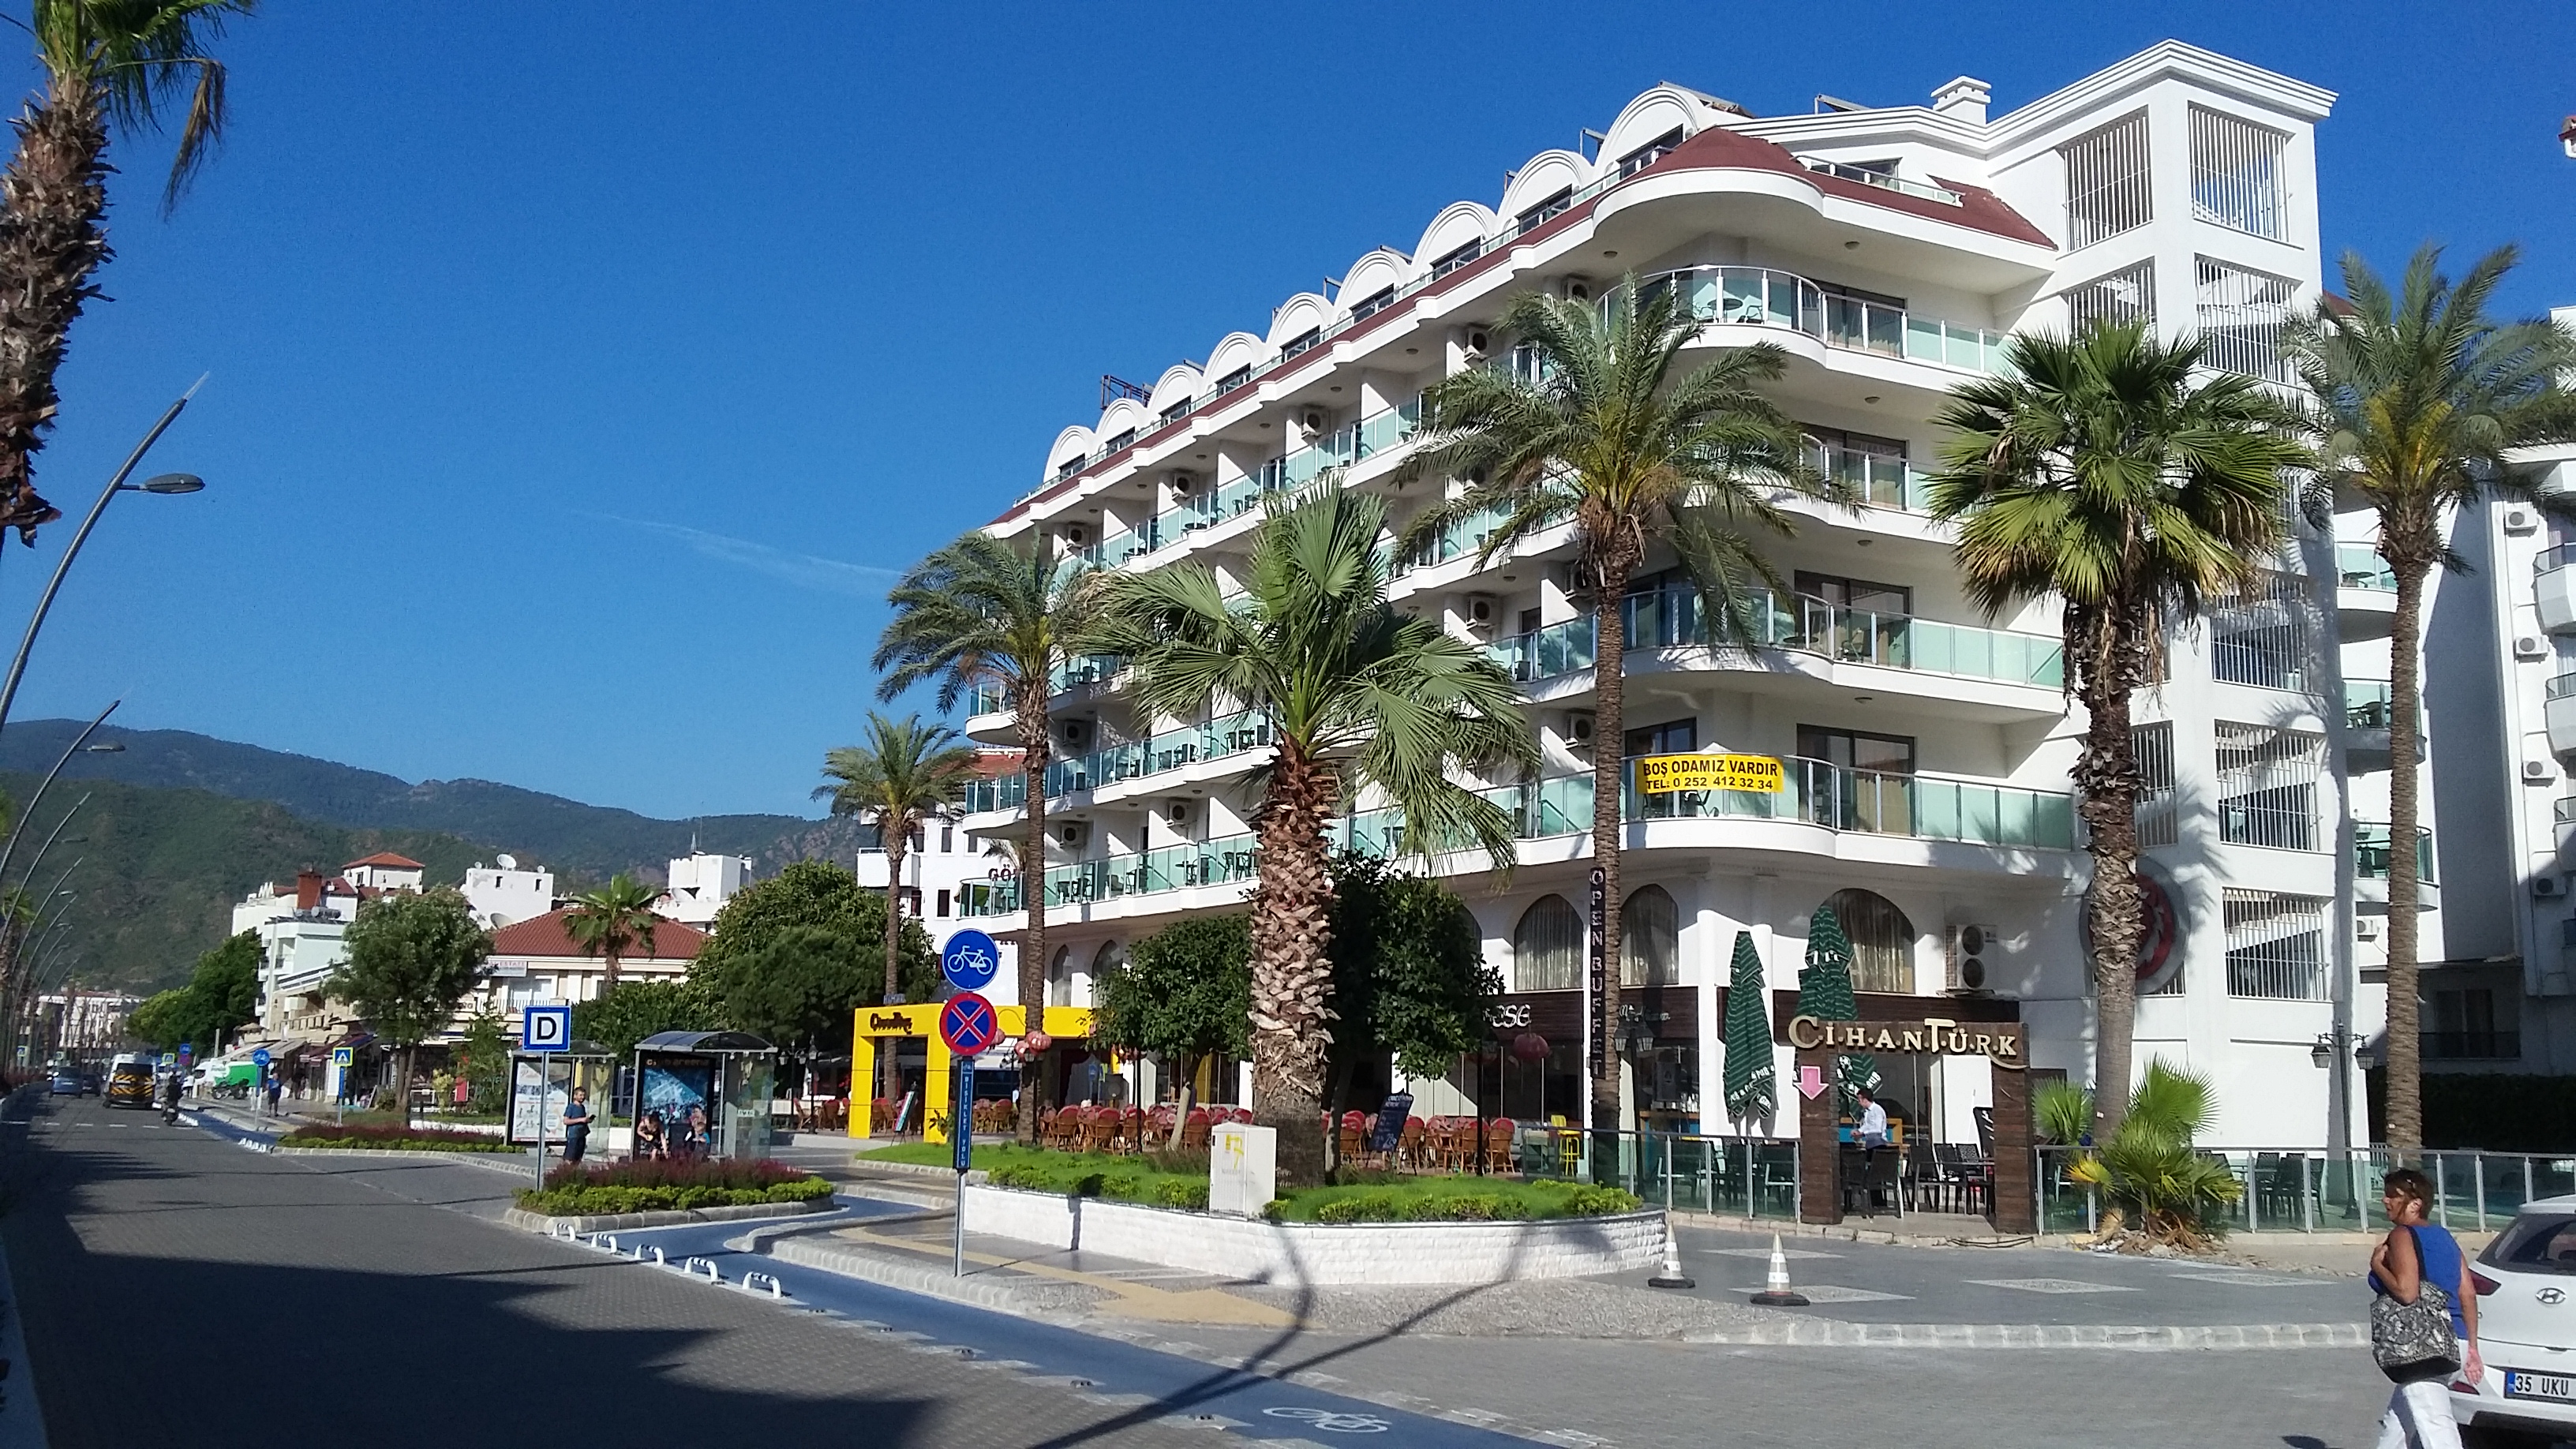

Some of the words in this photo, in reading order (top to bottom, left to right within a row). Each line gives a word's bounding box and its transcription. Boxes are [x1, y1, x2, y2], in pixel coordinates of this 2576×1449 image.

[1643, 761, 1668, 778] BOŞ
[1672, 760, 1725, 774] ODAMIZ
[1729, 760, 1778, 777] VARDIR
[1646, 779, 1670, 789] TEL:
[1673, 778, 1680, 788] 0
[1684, 777, 1707, 787] 252
[1713, 776, 1735, 787] 412
[1739, 777, 1754, 788] 32
[1758, 780, 1773, 789] 34
[1589, 870, 1604, 947] OPEN
[1591, 957, 1603, 1076] BUFFET
[537, 1016, 557, 1040] D
[2515, 1375, 2532, 1392] 35
[2541, 1377, 2569, 1396] UKU
